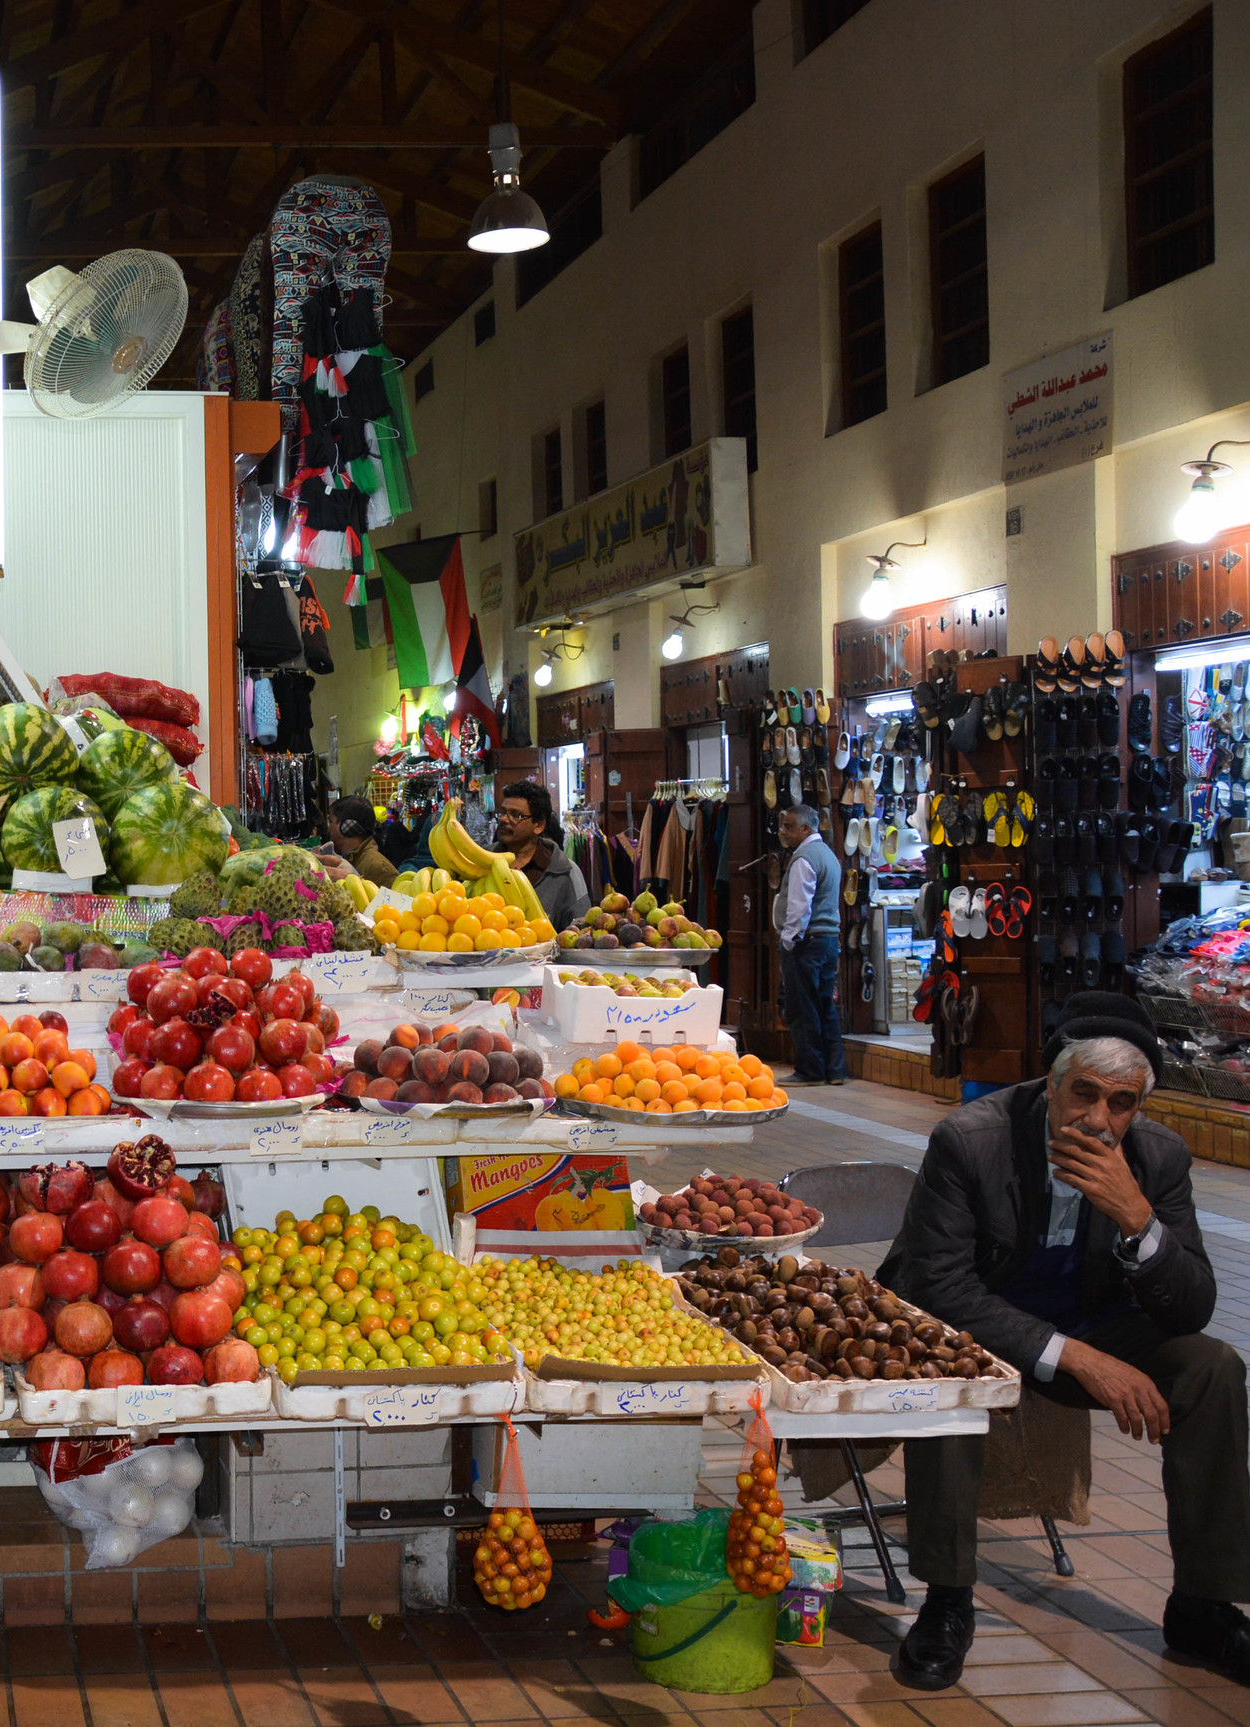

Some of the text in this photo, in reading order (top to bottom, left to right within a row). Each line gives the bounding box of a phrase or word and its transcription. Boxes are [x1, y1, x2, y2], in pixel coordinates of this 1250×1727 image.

[1078, 361, 1109, 386] محمد
[470, 1153, 545, 1194] Mangoes
[473, 1154, 498, 1171] Fresh
